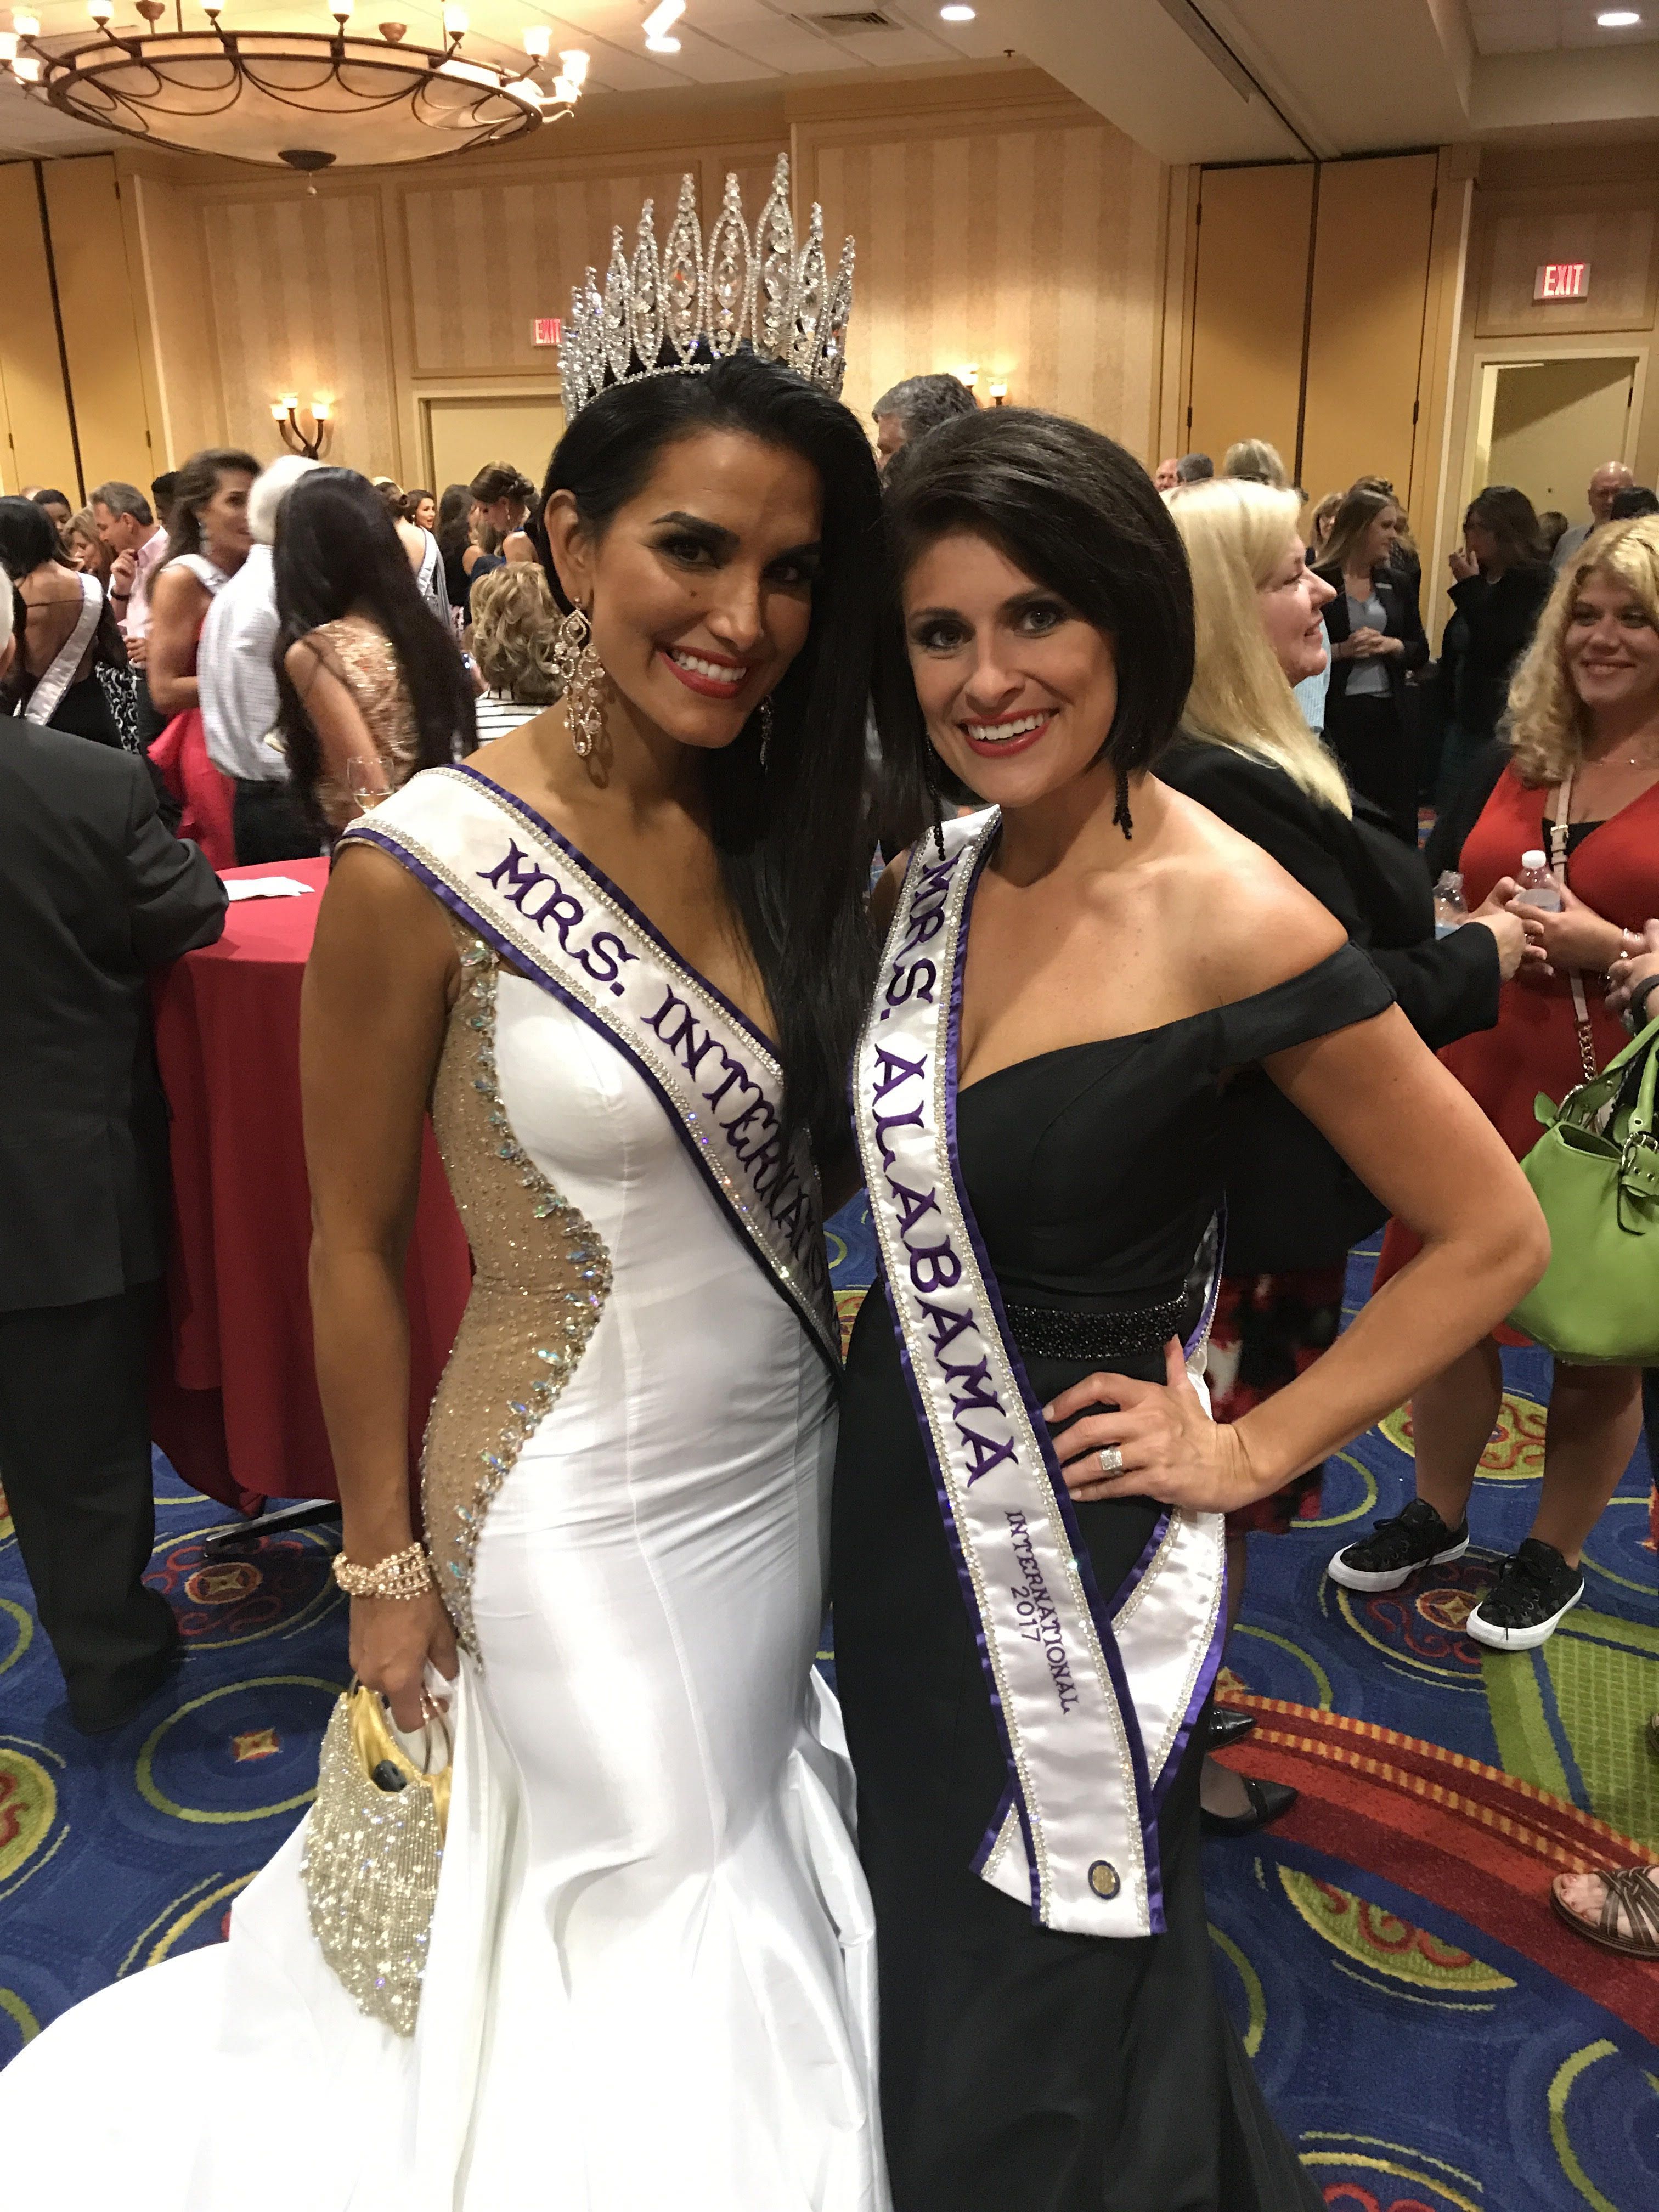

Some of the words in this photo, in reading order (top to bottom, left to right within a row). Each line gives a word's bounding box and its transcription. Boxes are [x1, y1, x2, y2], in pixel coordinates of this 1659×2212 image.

[534, 319, 561, 345] EXIT
[1543, 264, 1585, 297] EXIT
[477, 838, 639, 997] MRS.
[880, 844, 966, 1021] MRS.
[872, 1043, 1019, 1488] ALABAMA
[1004, 1510, 1079, 1715] INTERNATIONAL
[1010, 1586, 1041, 1642] 2017
